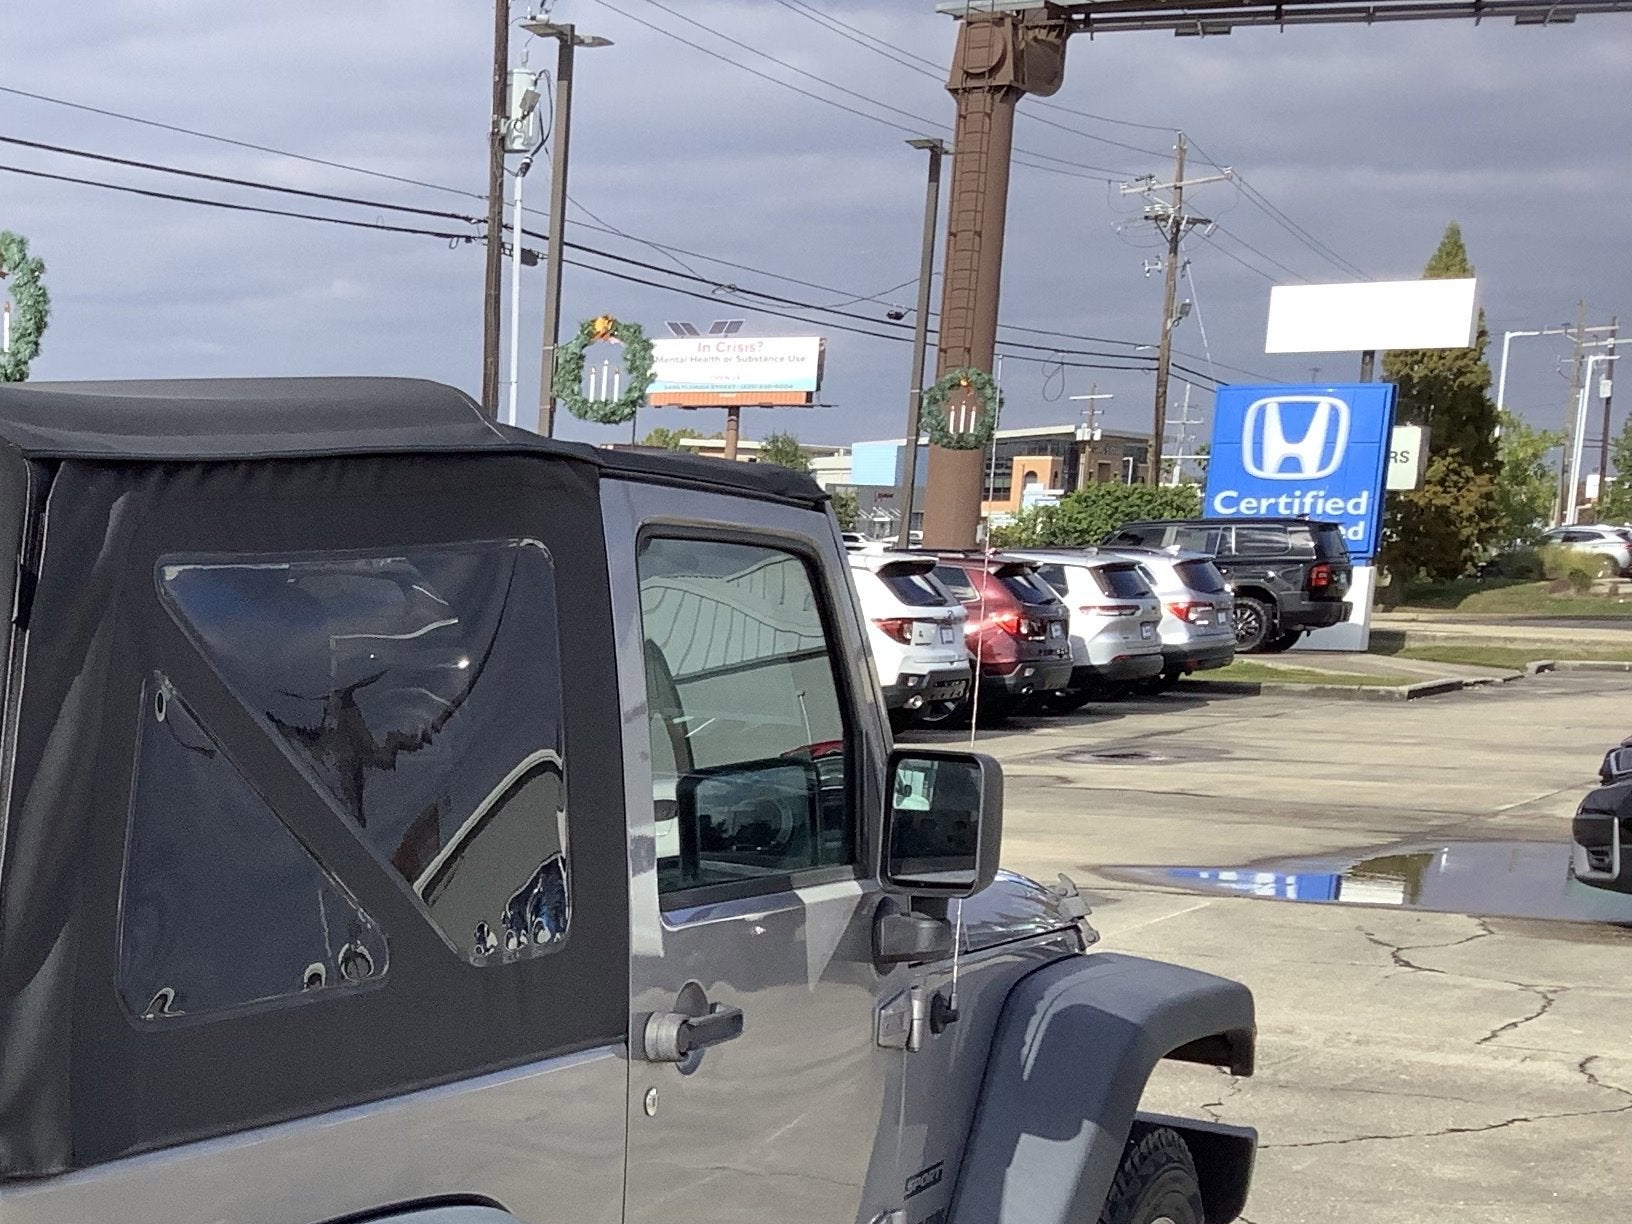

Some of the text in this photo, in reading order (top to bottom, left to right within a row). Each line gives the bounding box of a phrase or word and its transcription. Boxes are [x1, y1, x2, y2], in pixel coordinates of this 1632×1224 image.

[697, 341, 764, 353] In Crisis?
[654, 356, 687, 364] Mental
[690, 355, 721, 363] Health
[736, 354, 785, 363] Substance
[788, 355, 806, 363] Use
[1213, 490, 1369, 515] Certified
